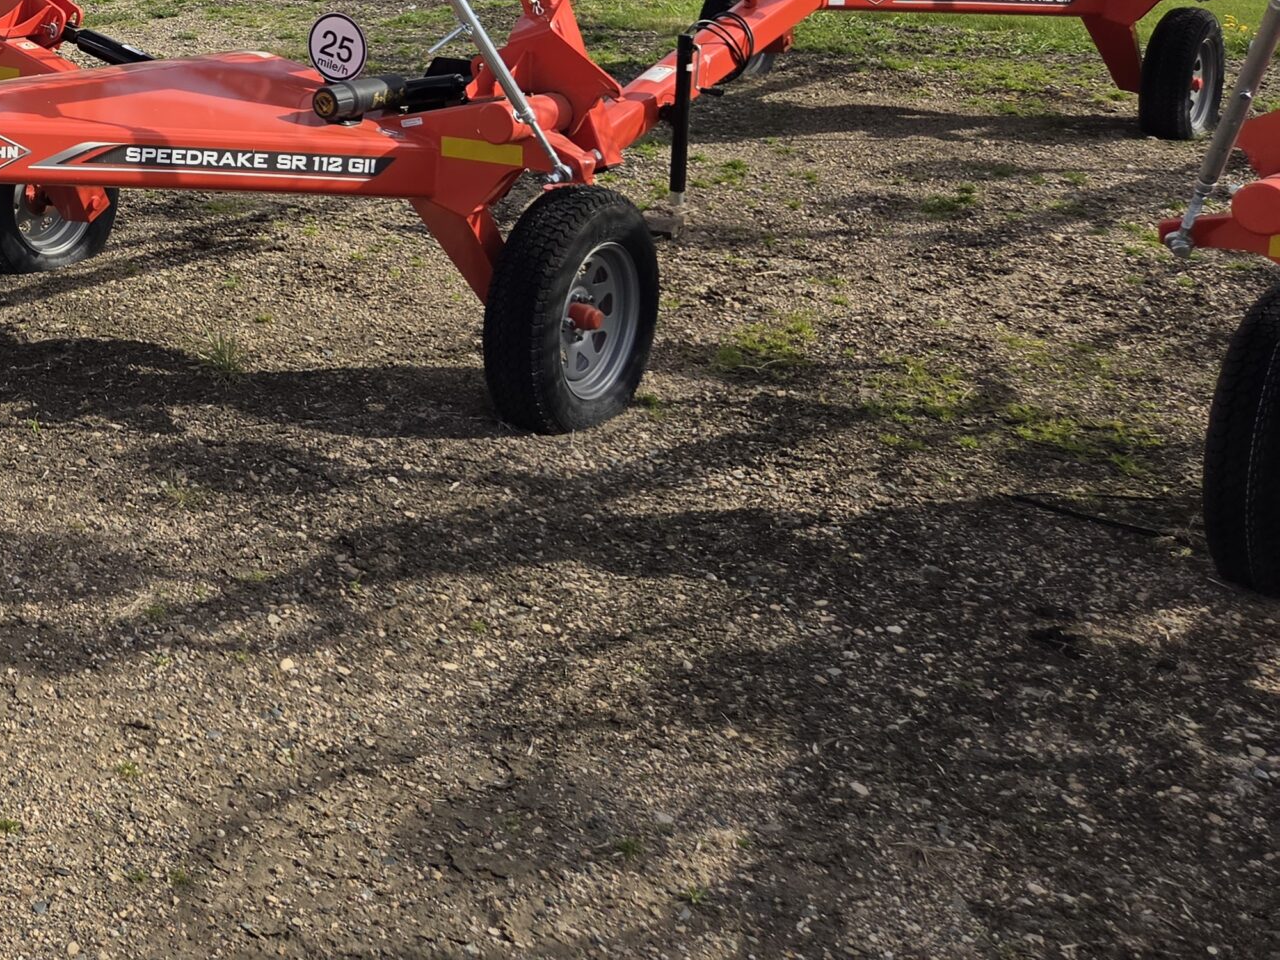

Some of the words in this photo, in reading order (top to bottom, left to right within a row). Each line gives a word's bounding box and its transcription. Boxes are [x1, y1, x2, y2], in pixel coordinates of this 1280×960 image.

[319, 30, 354, 63] 25
[316, 57, 349, 76] mile/h
[125, 147, 268, 169] SPEEDRAKE
[276, 154, 307, 171] SR
[312, 156, 342, 172] 112
